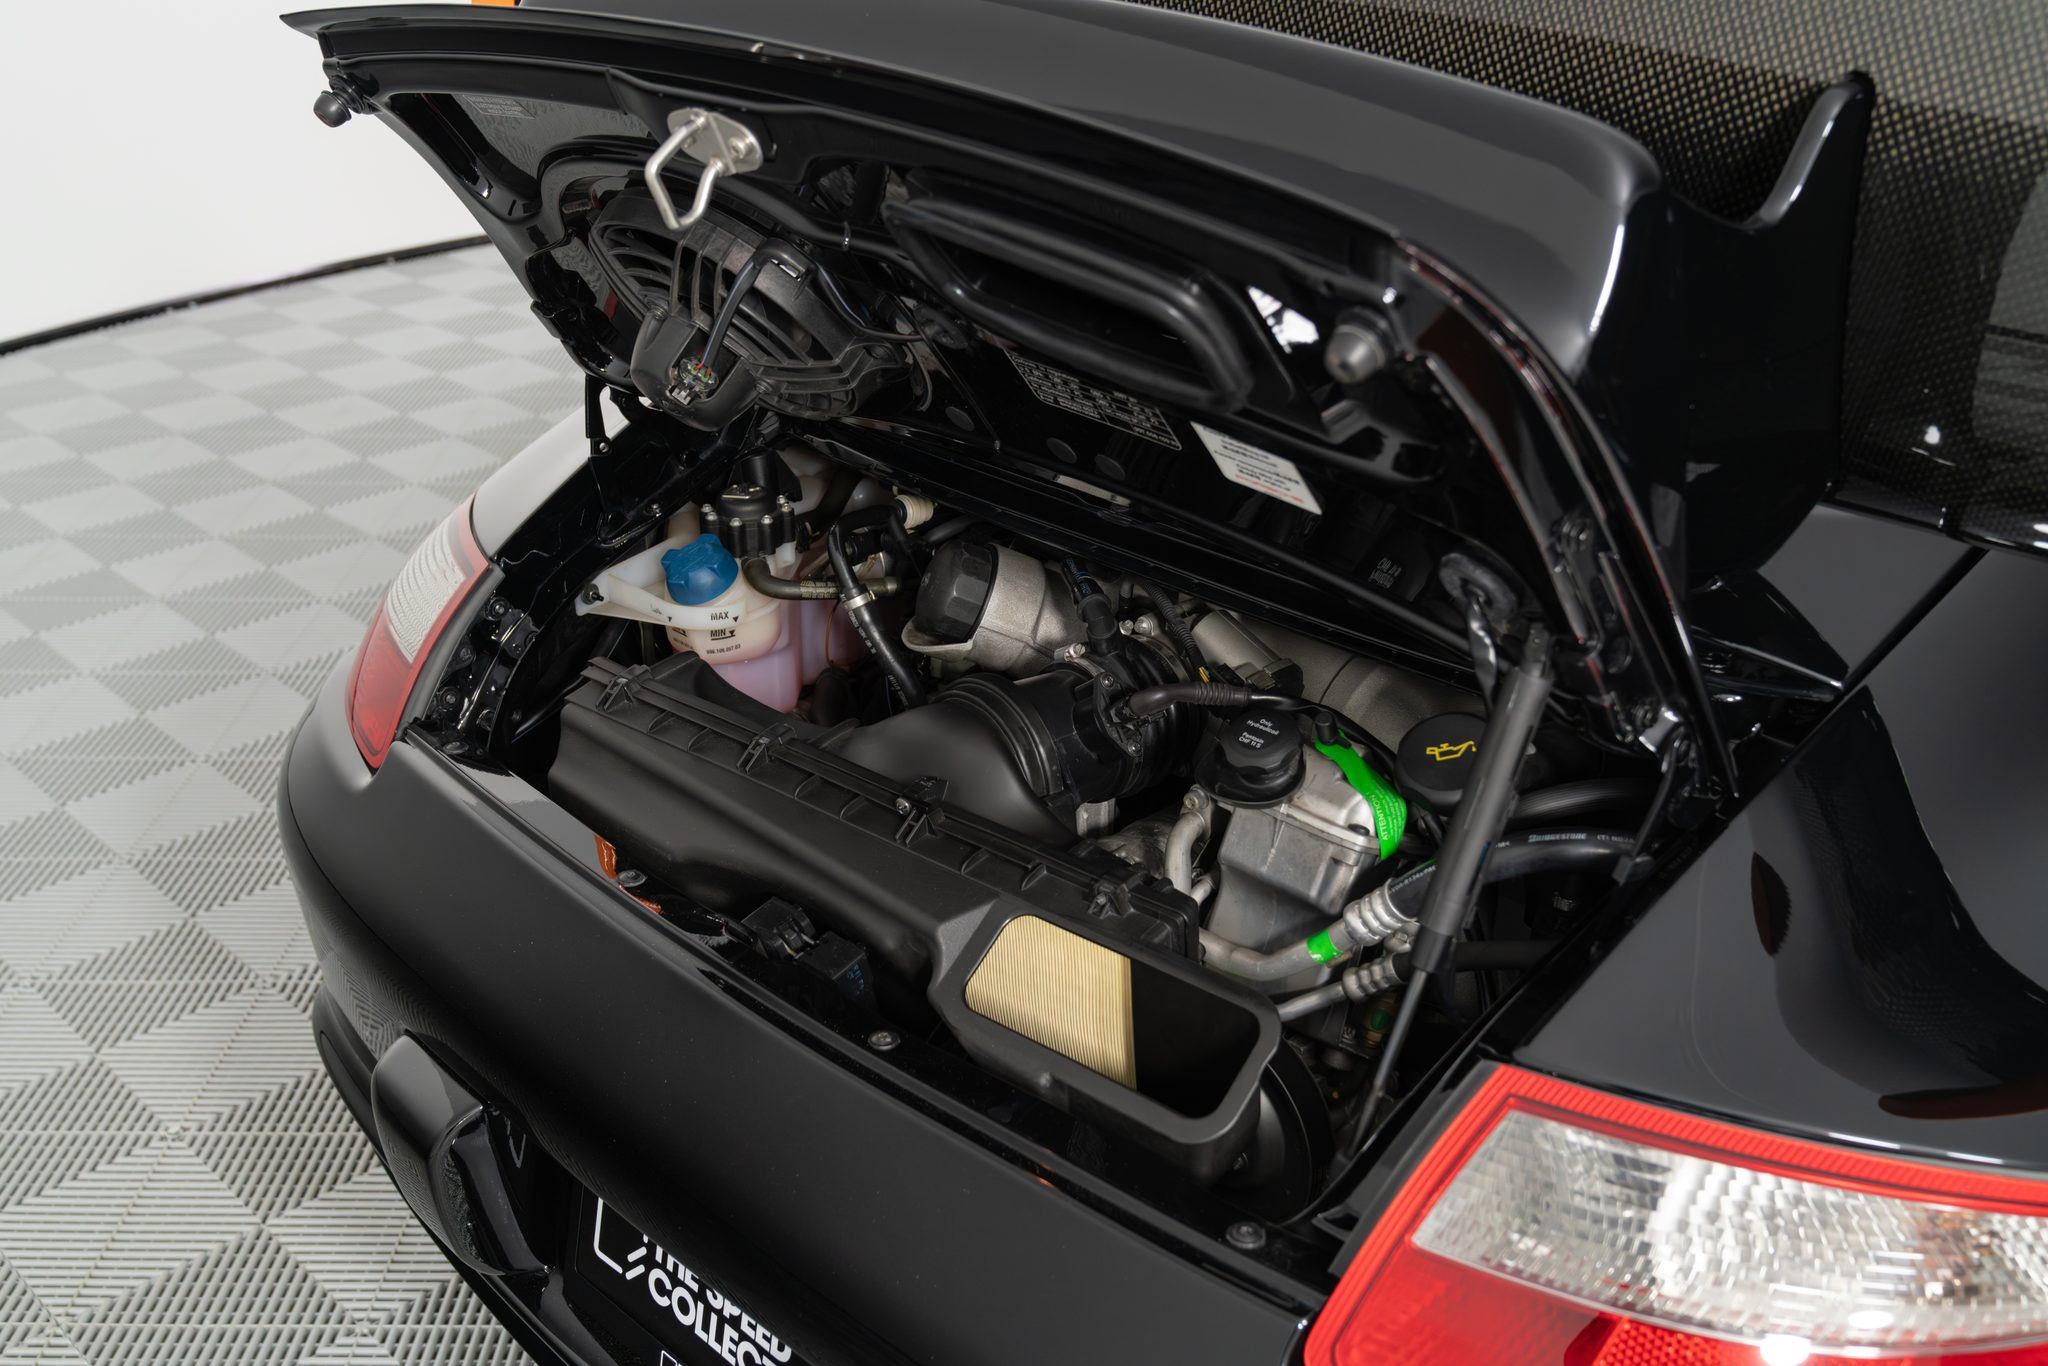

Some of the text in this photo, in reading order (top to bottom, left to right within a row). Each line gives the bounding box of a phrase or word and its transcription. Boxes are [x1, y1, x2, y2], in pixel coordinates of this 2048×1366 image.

[710, 611, 729, 621] MAX
[710, 628, 726, 637] MIN
[1369, 794, 1389, 841] ATTENTION
[648, 1268, 777, 1366] COLLEC
